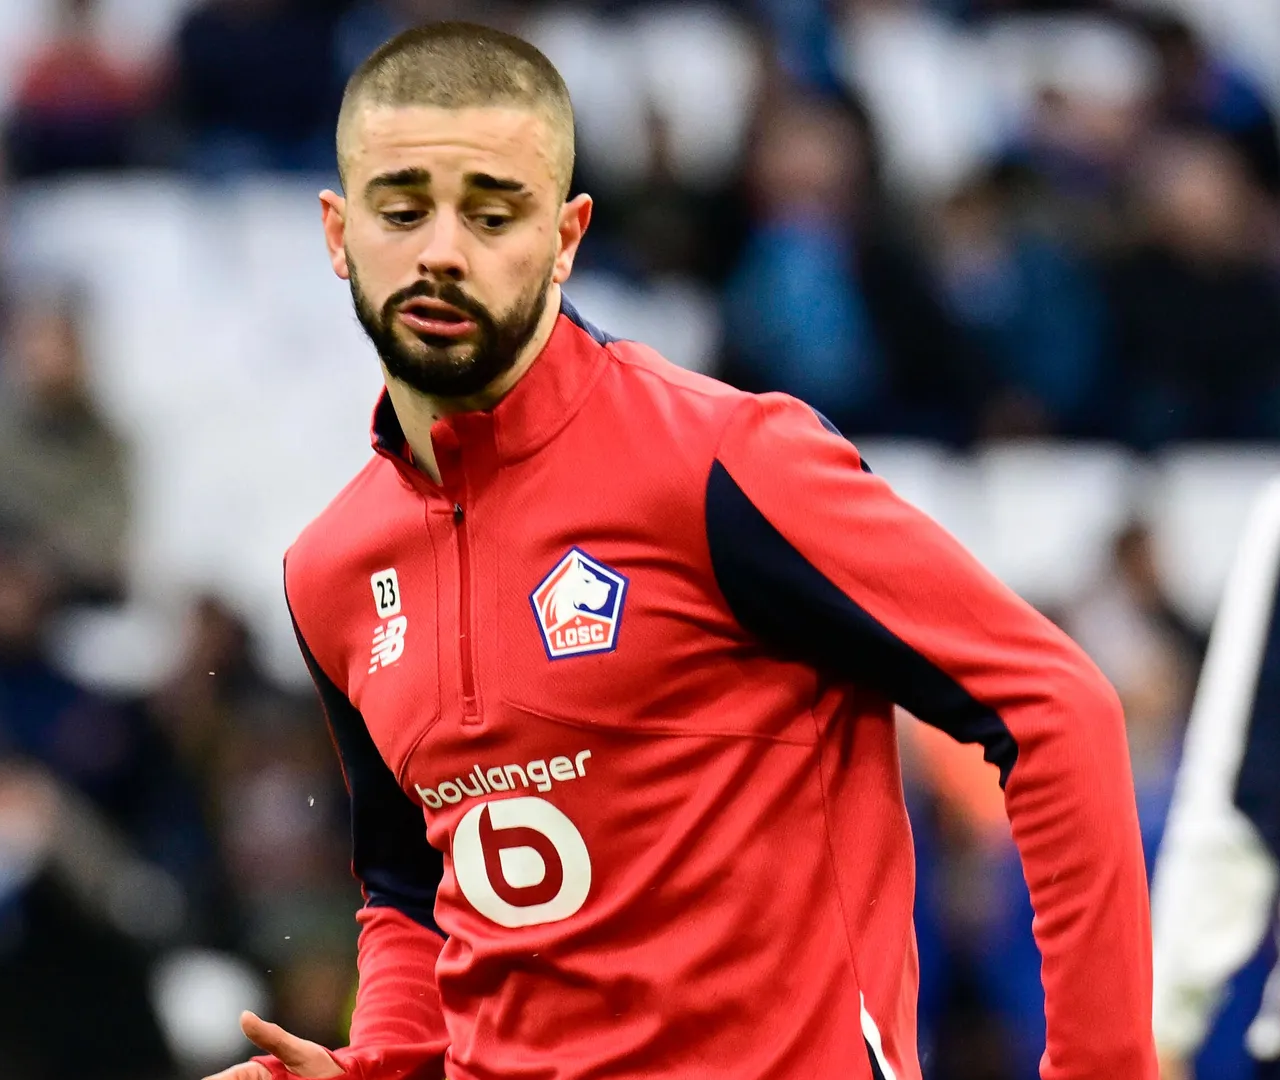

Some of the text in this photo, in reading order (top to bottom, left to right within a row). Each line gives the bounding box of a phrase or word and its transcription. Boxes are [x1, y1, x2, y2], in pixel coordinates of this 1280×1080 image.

[376, 577, 396, 610] 23
[555, 623, 605, 649] LOSC
[414, 749, 592, 810] boulanger
